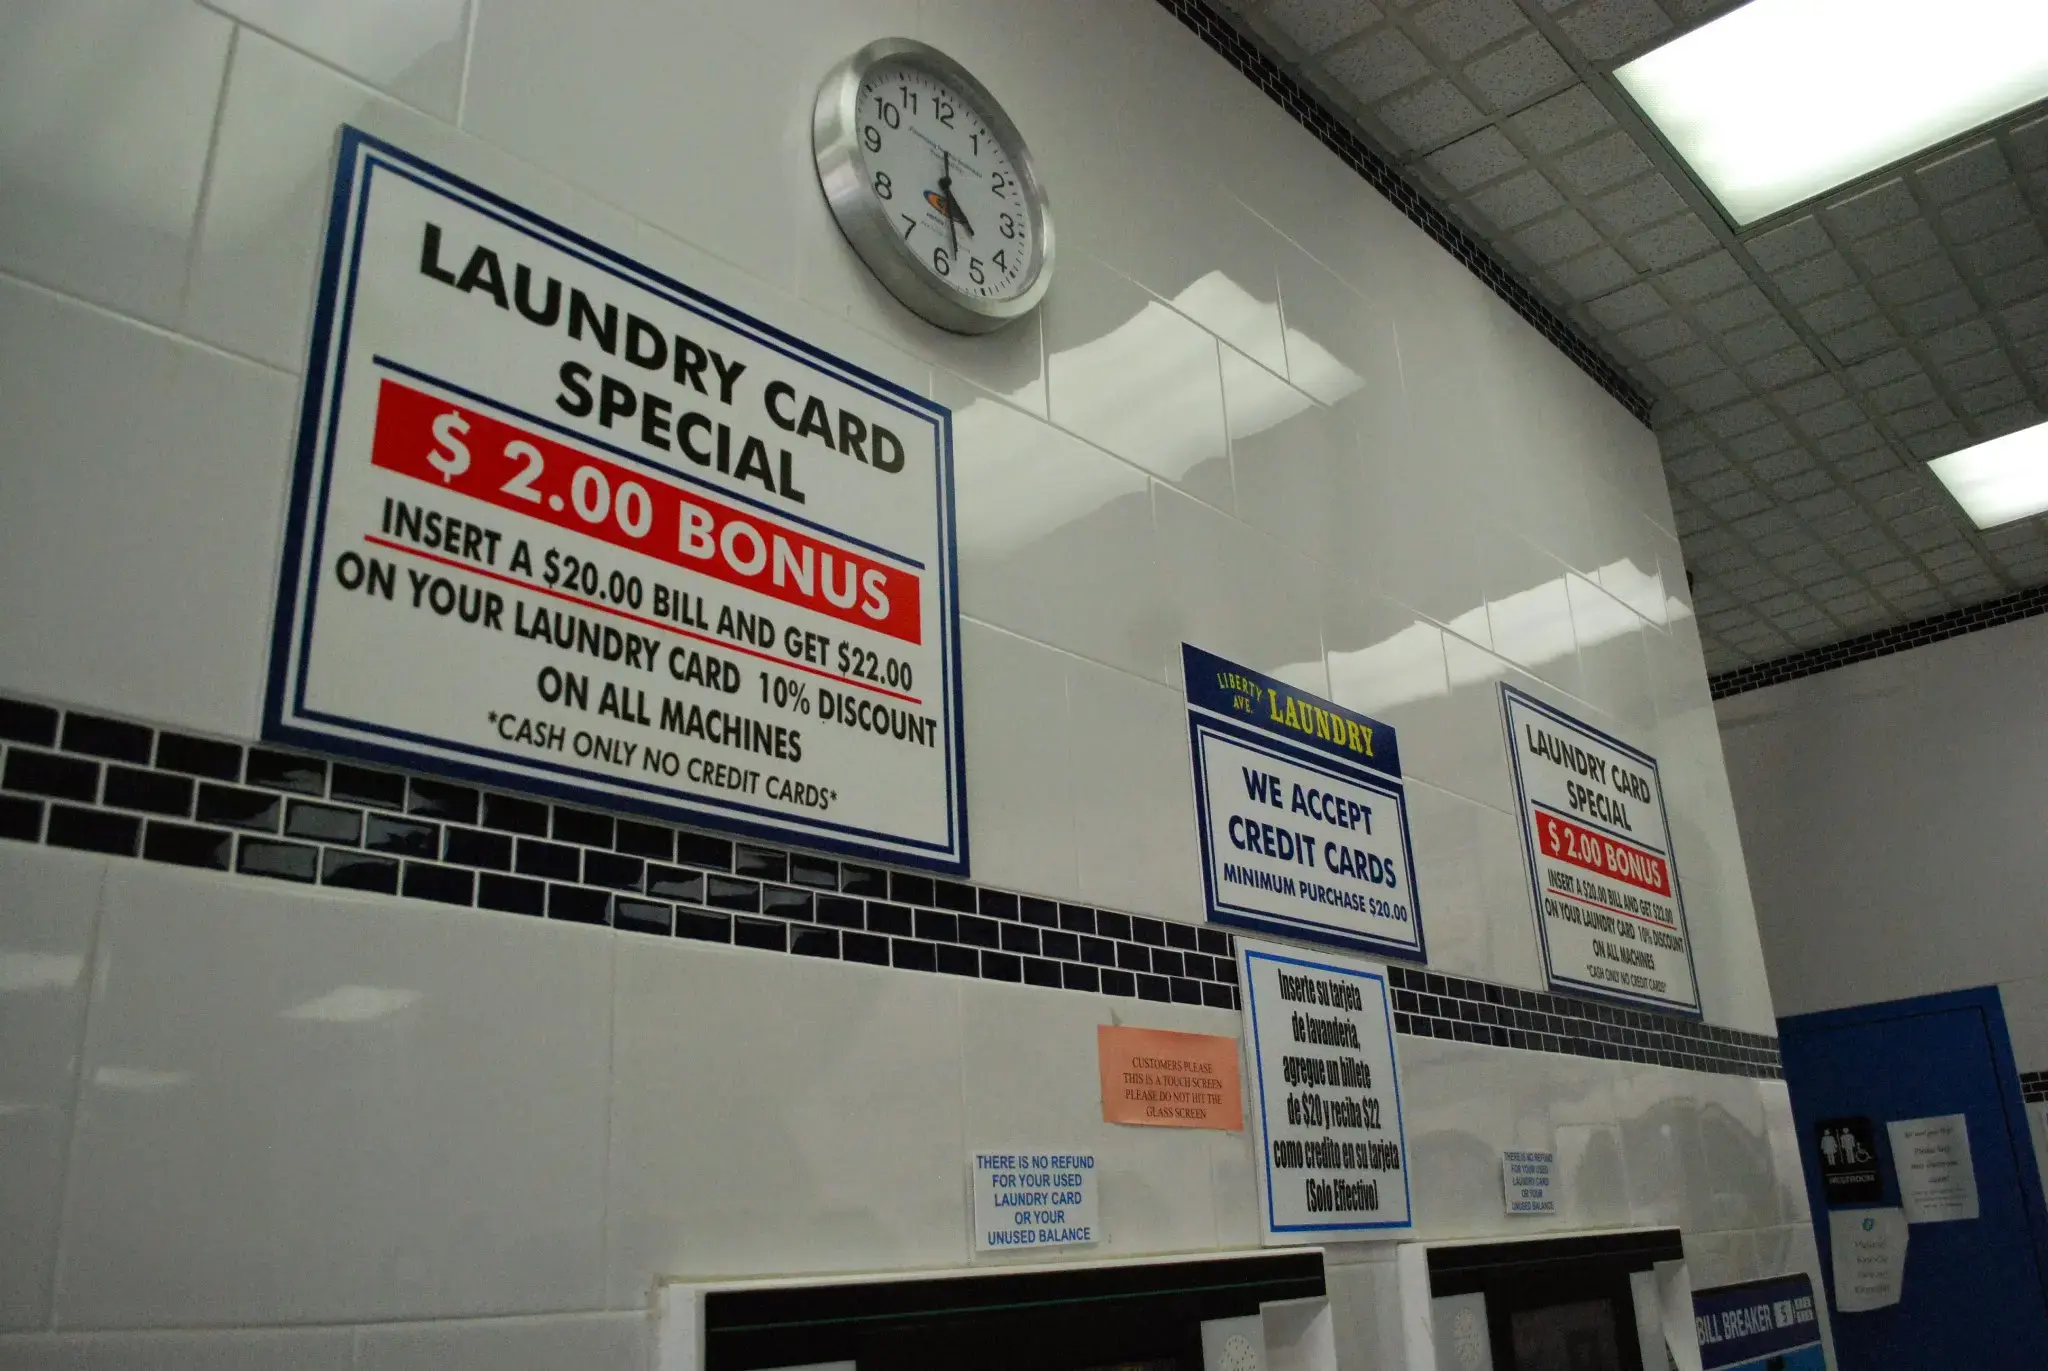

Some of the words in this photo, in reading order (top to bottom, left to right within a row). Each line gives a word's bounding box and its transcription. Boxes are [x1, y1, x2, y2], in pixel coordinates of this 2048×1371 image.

[875, 98, 900, 129] 10
[900, 86, 917, 115] 11
[932, 97, 954, 130] 12
[865, 125, 881, 153] 9
[970, 134, 978, 156] 1
[875, 171, 892, 200] 8
[992, 171, 1006, 199] 2
[901, 214, 917, 240] 7
[1000, 213, 1015, 240] 3
[933, 247, 950, 276] 6
[969, 257, 985, 285] 5
[992, 249, 1007, 273] 4
[420, 223, 747, 407] LAUNDRY
[764, 380, 904, 474] CARD
[556, 361, 805, 505] SPECIAL
[427, 411, 471, 484] $
[501, 441, 652, 539] 2.00
[679, 505, 890, 621] BONUS
[382, 497, 502, 567] INSERT
[509, 541, 534, 577] A
[543, 547, 643, 610] $20.00
[653, 583, 708, 632] BILL
[716, 608, 776, 650] AND
[784, 625, 830, 665] GET
[837, 640, 913, 692] $22.00
[336, 551, 395, 601] ON
[408, 572, 503, 631] YOUR
[515, 603, 661, 673] LAUNDRY
[668, 647, 740, 694] CARD
[758, 672, 811, 715] 10%
[819, 689, 937, 748] DISCOUNT
[1217, 673, 1263, 703] LIBERTY
[1233, 695, 1252, 713] AVE.
[538, 666, 589, 711] ON
[599, 689, 651, 730] ALL
[660, 704, 803, 763] MACHINES
[1268, 688, 1374, 758] LAUNDRY
[573, 733, 637, 770] ONLY
[642, 748, 680, 777] NO
[688, 759, 761, 796] CREDIT
[1526, 724, 1606, 785] LAUNDRY
[1611, 765, 1650, 804] CARD
[1241, 766, 1283, 809] WE
[1291, 783, 1372, 835] ACCEPT
[1567, 780, 1632, 832] SPECIAL
[1229, 815, 1315, 867] CREDIT
[1324, 841, 1396, 888] CARDS
[1548, 819, 1560, 857] $
[1566, 826, 1602, 868] 2.00
[1606, 841, 1662, 888] BONUS
[1224, 863, 1295, 896] MINIMUM
[1299, 881, 1366, 912] PURCHASE
[1370, 898, 1408, 922] $20.00
[1548, 868, 1574, 893] INSERT
[1577, 884, 1582, 896] A
[1583, 880, 1608, 903] $20.00
[1607, 888, 1623, 909] BILL
[1624, 894, 1639, 913] AND
[1639, 899, 1652, 918] GET
[1653, 903, 1674, 925] $22.00
[1545, 898, 1559, 918] ON
[1560, 902, 1582, 925] YOUR
[1582, 908, 1615, 935] LAUNDRY
[1617, 919, 1635, 939] CARD
[1638, 925, 1652, 945] 10%
[1652, 930, 1684, 953] DISCOUNT
[1592, 938, 1606, 958] ON
[1607, 943, 1620, 962] ALL
[1621, 946, 1655, 970] MACHINES
[1278, 968, 1316, 1005] Inserte
[1316, 982, 1330, 1006] su
[1329, 979, 1362, 1012] tarjeta
[1292, 1010, 1305, 1043] de
[1123, 1073, 1143, 1085] THIS
[1145, 1074, 1154, 1085] IS
[1155, 1076, 1162, 1086] A
[1162, 1075, 1191, 1088] TOUCH
[1192, 1078, 1222, 1089] SCREEN
[1132, 1056, 1182, 1071] CUSTOMERS
[1184, 1062, 1212, 1073] PLEASE
[1283, 1055, 1326, 1088] agregue
[1326, 1059, 1340, 1087] un
[1339, 1055, 1371, 1089] billete
[1125, 1089, 1157, 1101] PLEASE
[1160, 1091, 1172, 1102] DO
[1174, 1092, 1190, 1103] NOT
[1192, 1093, 1205, 1104] HIT
[1207, 1093, 1222, 1104] THE
[1146, 1106, 1174, 1118] GLASS
[1174, 1108, 1207, 1119] SCREEN
[1287, 1092, 1301, 1125] de
[1302, 1091, 1322, 1128] $20
[1323, 1100, 1331, 1130] y
[1330, 1097, 1362, 1128] reciba
[1362, 1096, 1381, 1130] $22
[976, 1155, 1016, 1169] THERE
[1018, 1156, 1029, 1169] IS
[1032, 1156, 1048, 1169] NO
[1051, 1155, 1094, 1169] REFUND
[1273, 1140, 1304, 1169] como
[1305, 1136, 1341, 1169] credito
[1342, 1141, 1356, 1169] en
[1356, 1142, 1368, 1169] su
[1368, 1139, 1400, 1173] tarjeta
[992, 1174, 1016, 1187] FOR
[1018, 1174, 1050, 1187] YOUR
[1053, 1173, 1082, 1186] USED
[1306, 1178, 1333, 1212] (Solo
[994, 1192, 1048, 1207] LAUNDRY
[1051, 1192, 1082, 1205] CARD
[1014, 1211, 1031, 1225] OR
[1034, 1210, 1065, 1223] YOUR
[988, 1229, 1035, 1245] UNUSED
[1039, 1227, 1091, 1242] BALANCE
[1695, 1314, 1723, 1346] BILL
[1722, 1304, 1773, 1340] BREAKER
